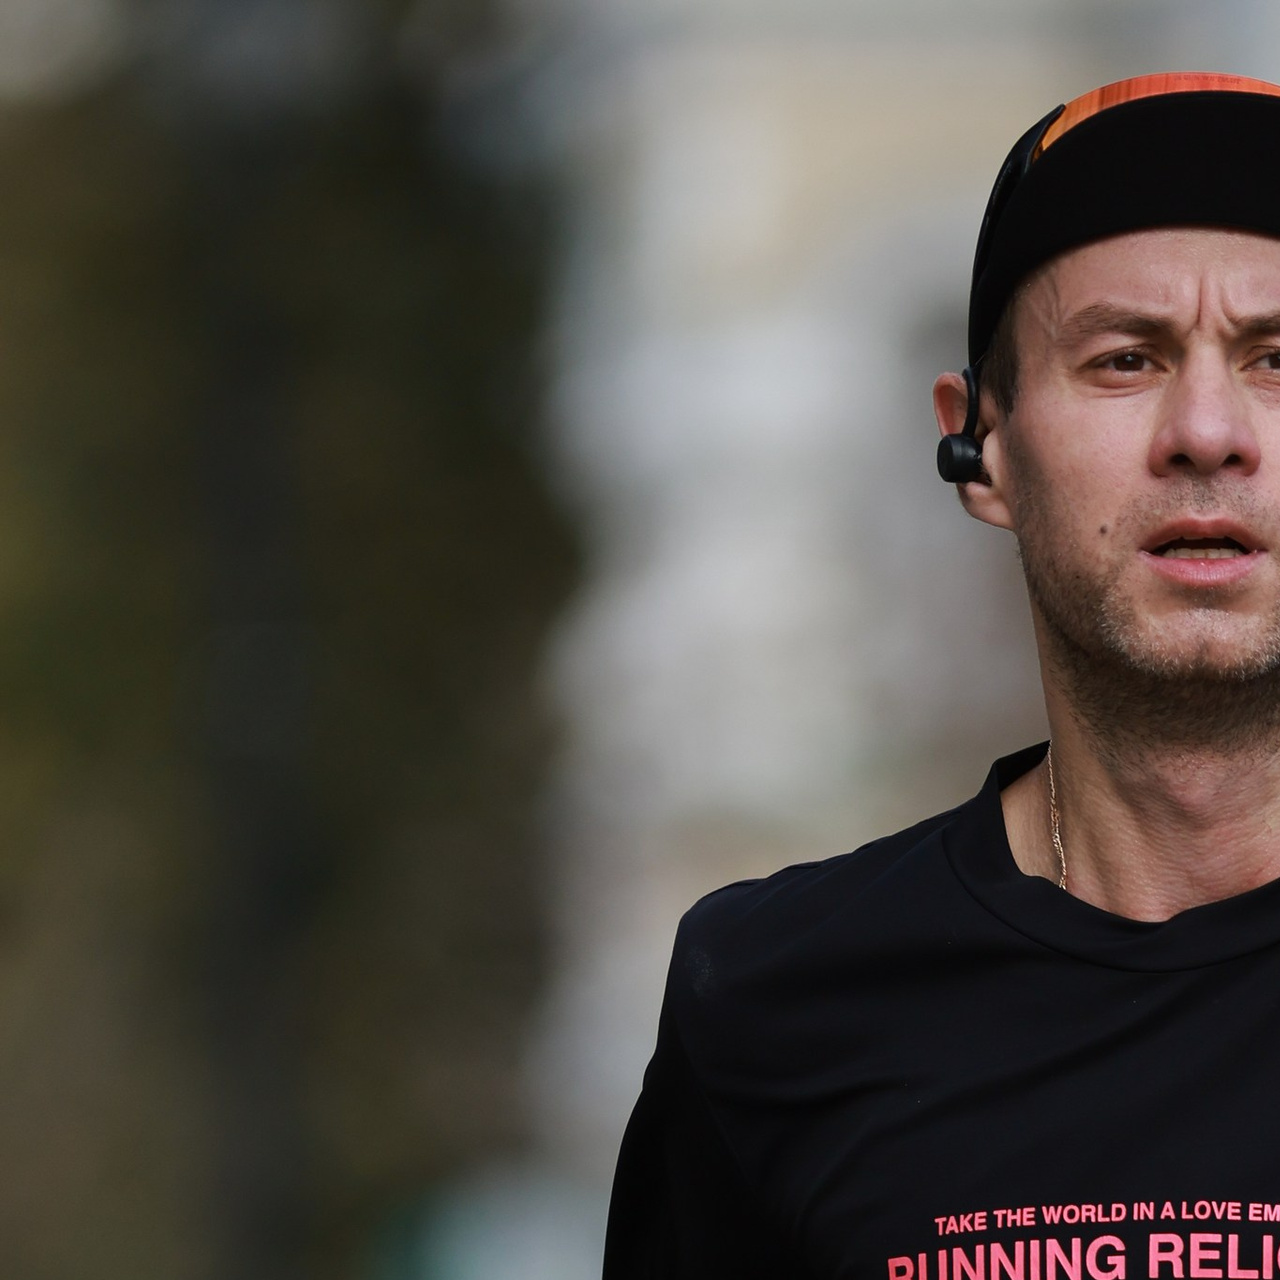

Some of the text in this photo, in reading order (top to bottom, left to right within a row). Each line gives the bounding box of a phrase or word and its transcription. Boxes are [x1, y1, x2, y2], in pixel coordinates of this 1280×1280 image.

[934, 1210, 987, 1236] TAKE
[993, 1206, 1036, 1228] THE
[1041, 1202, 1127, 1225] WORLD
[1132, 1201, 1155, 1221] IN
[1160, 1200, 1176, 1220] A
[1180, 1199, 1242, 1221] LOVE
